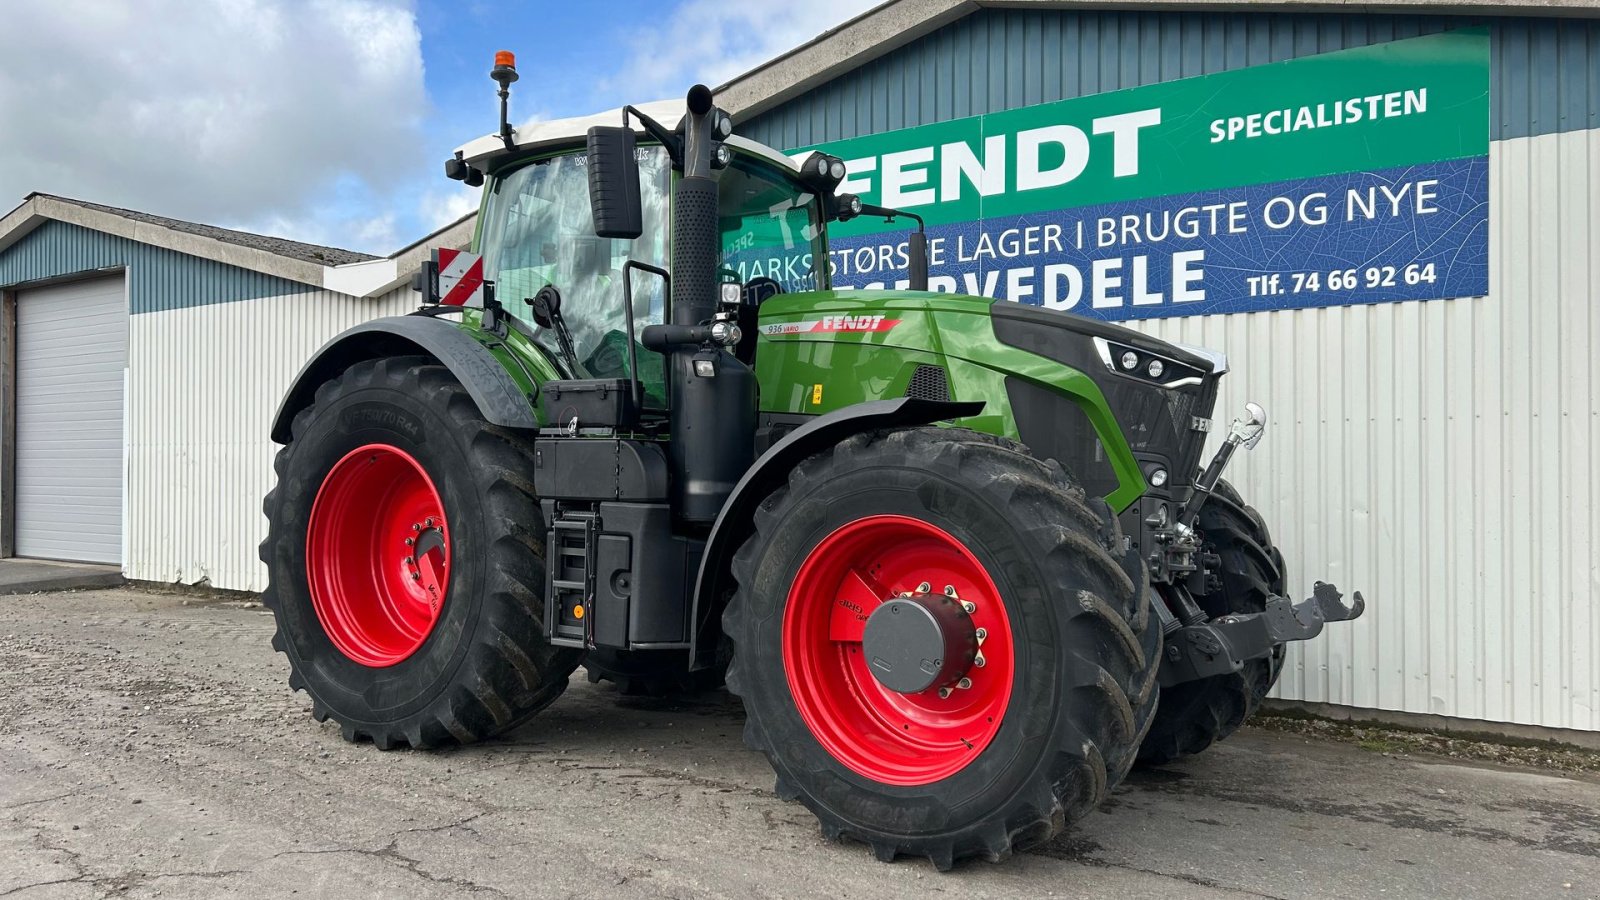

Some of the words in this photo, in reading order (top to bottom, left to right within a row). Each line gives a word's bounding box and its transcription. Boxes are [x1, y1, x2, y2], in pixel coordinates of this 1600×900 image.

[1210, 87, 1428, 143] SPECIALISTEN
[958, 224, 1063, 262] LAGER
[1077, 220, 1083, 250] I
[1097, 202, 1248, 248] BRUGTE
[1263, 192, 1327, 229] OG
[1347, 179, 1438, 222] NYE
[1247, 273, 1285, 297] Tlf.
[1291, 271, 1321, 292] 74
[1327, 268, 1357, 290] 66
[1365, 265, 1396, 288] 92
[1404, 262, 1437, 284] 64
[768, 324, 783, 334] 936
[783, 325, 799, 333] VARIO
[822, 315, 886, 330] FENDT
